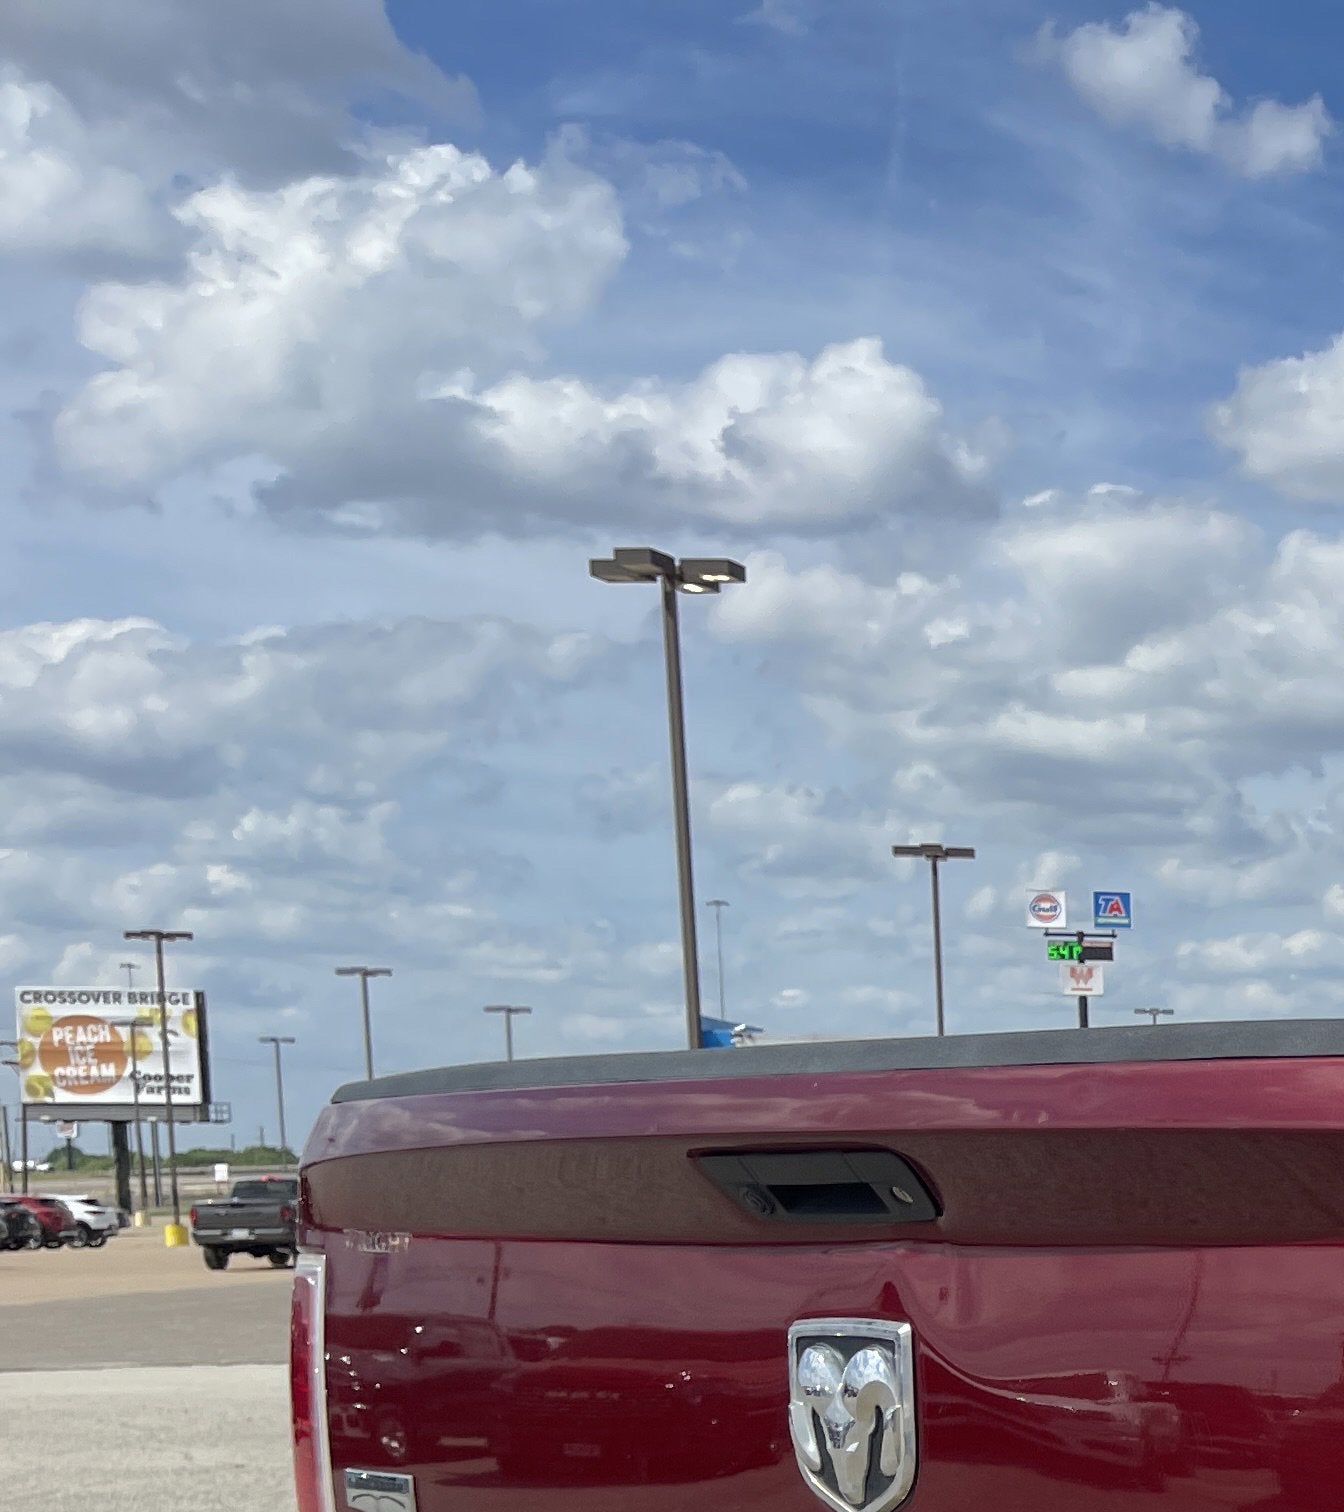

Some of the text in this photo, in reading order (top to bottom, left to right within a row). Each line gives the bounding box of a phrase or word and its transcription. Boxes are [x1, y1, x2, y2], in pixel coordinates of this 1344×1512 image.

[20, 991, 122, 1005] CROSSOVER
[52, 1024, 111, 1047] PEACH
[67, 1043, 98, 1066] ICE
[54, 1063, 116, 1088] CREAM
